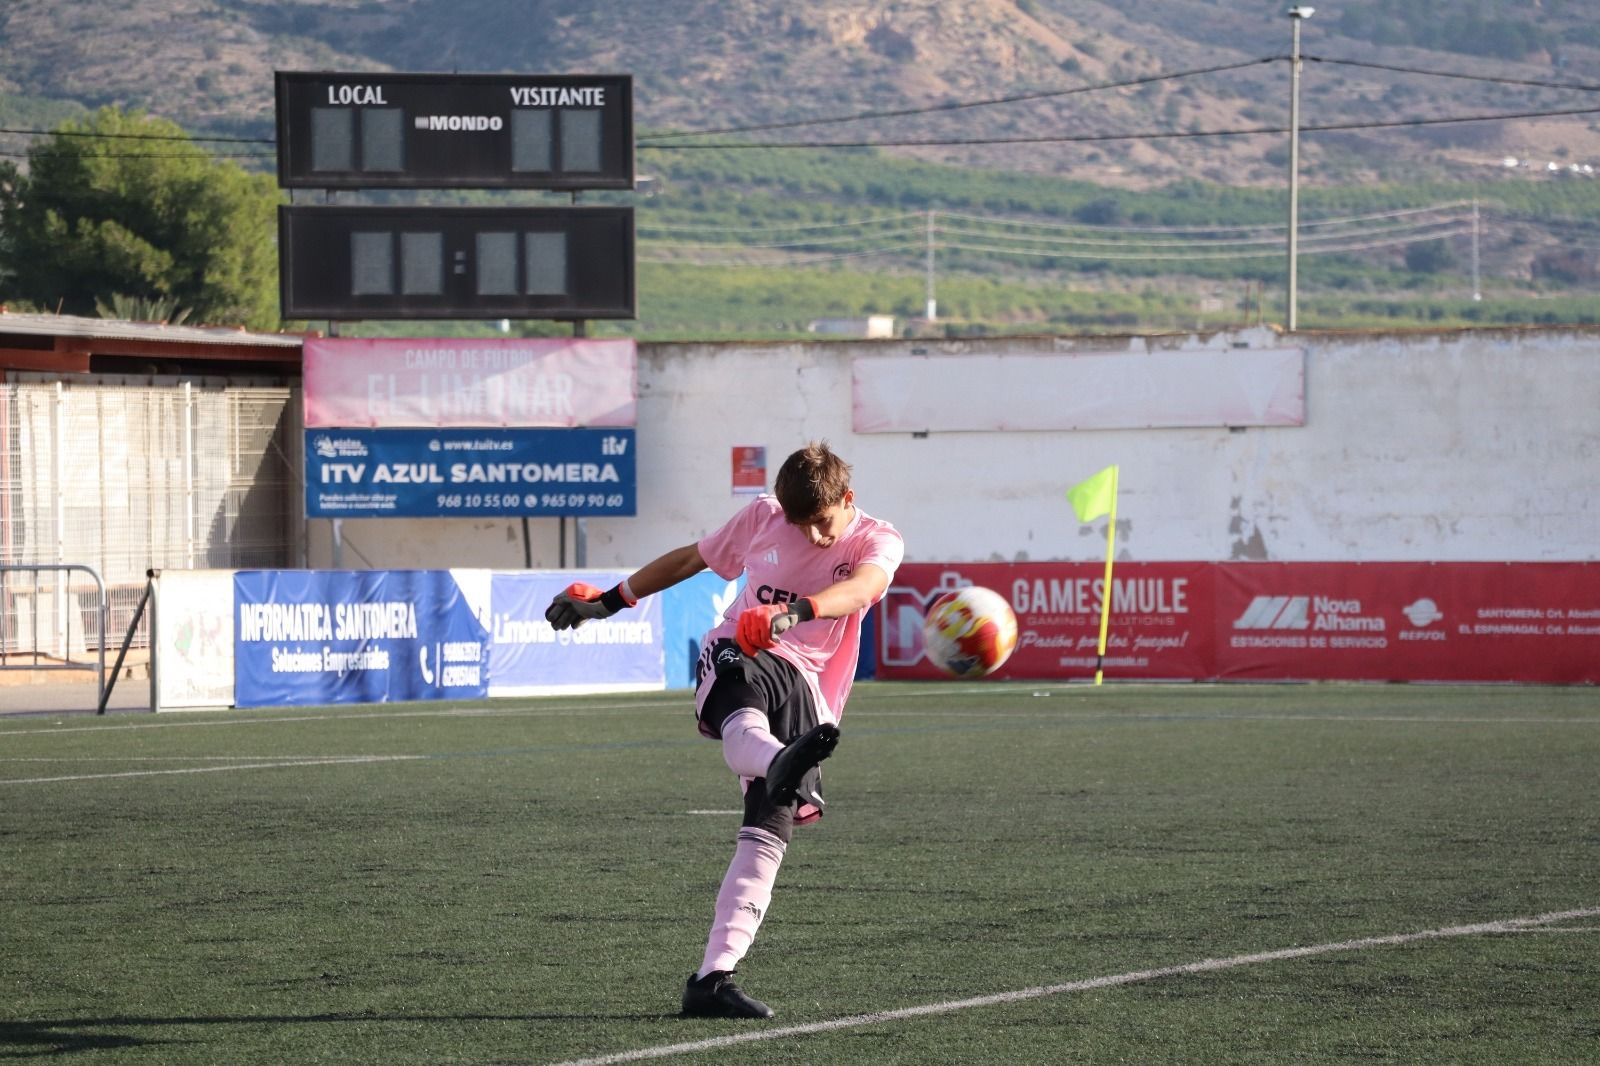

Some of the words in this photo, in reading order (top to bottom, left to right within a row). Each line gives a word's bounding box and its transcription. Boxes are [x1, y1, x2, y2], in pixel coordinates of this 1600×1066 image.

[327, 85, 388, 105] LOCAL
[509, 86, 606, 107] VISITANTE
[429, 115, 503, 132] MONDO
[405, 350, 456, 369] CAMPO
[462, 349, 479, 369] DE
[367, 373, 400, 416] EL
[321, 463, 366, 484] ITV
[372, 463, 444, 484] AZUL
[450, 463, 620, 484] SANTOMERA
[436, 494, 462, 508] 968
[464, 494, 482, 508] 10
[484, 494, 500, 508] 55
[502, 494, 520, 508] 00
[541, 494, 566, 508] 965
[567, 494, 586, 508] 09
[587, 494, 604, 508] 90
[606, 494, 624, 508] 60
[1313, 597, 1361, 613] Nova
[240, 603, 333, 642] INFORMATICA
[335, 602, 418, 641] SANTOMERA
[1027, 616, 1086, 626] GAMING
[1090, 616, 1176, 626] SLUTIONS
[1313, 614, 1385, 631] Alhama
[1231, 636, 1307, 648] ESTACIONES
[1309, 636, 1327, 648] DE
[1330, 636, 1388, 648] SERVICIO
[1398, 631, 1446, 641] REPSOL
[272, 647, 322, 672] Soluciones
[323, 647, 389, 676] Empresariales
